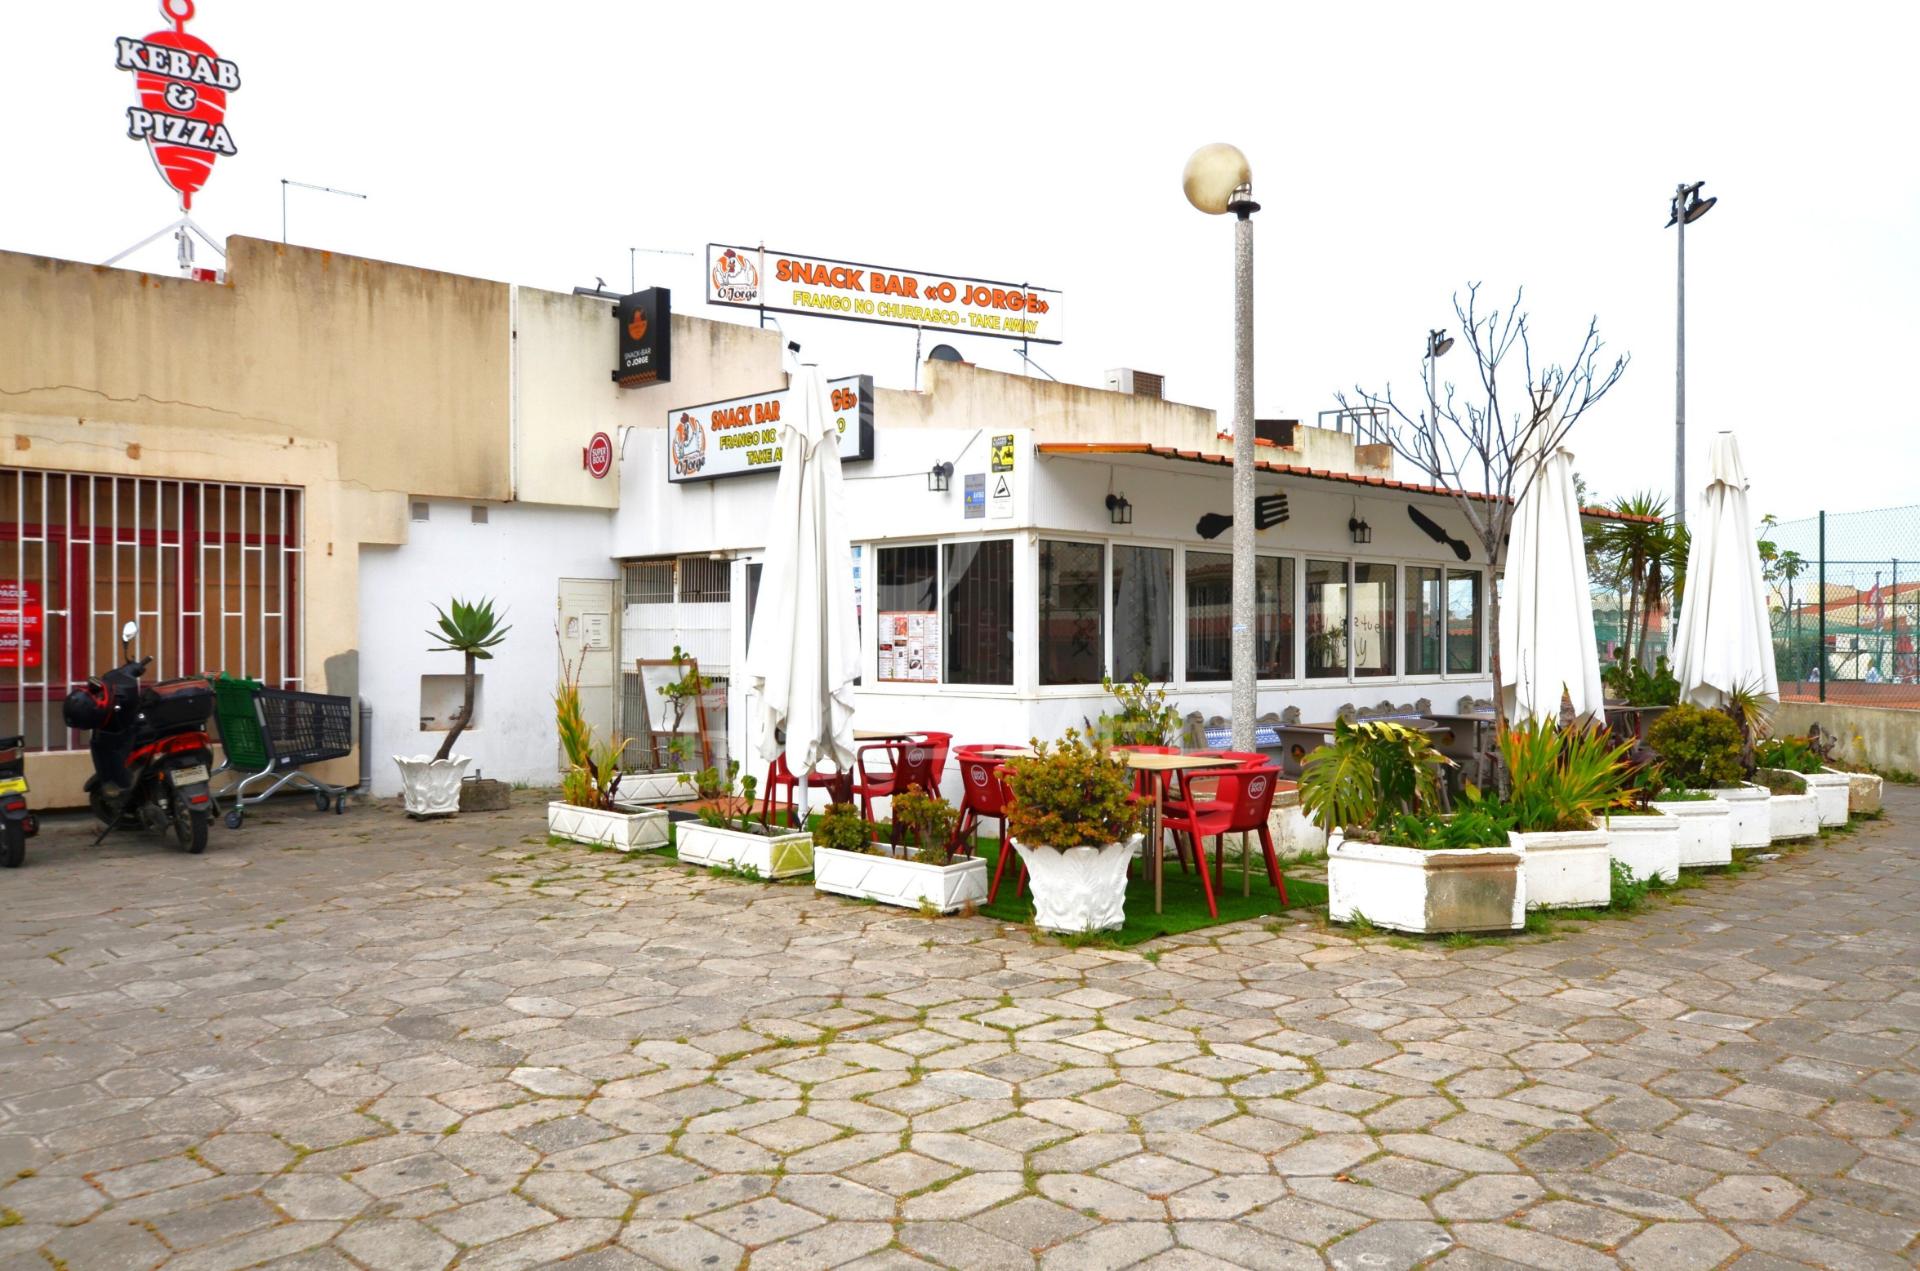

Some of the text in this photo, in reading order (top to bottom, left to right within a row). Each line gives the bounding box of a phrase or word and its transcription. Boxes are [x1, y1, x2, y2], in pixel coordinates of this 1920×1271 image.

[117, 37, 240, 91] KEBAB
[165, 82, 196, 110] &
[128, 107, 237, 155] PIZZA
[776, 259, 864, 291] SNACK
[870, 272, 919, 298] BAR
[793, 291, 851, 311] FRANGO
[855, 298, 874, 314] NO
[878, 301, 959, 325] CHURRASCO
[968, 313, 1001, 330] TAKE
[1003, 317, 1038, 334] AWAY
[711, 405, 752, 431] SNACK
[755, 400, 780, 424] BAR
[719, 431, 760, 450] FRANGO
[746, 449, 773, 465] TAKE
